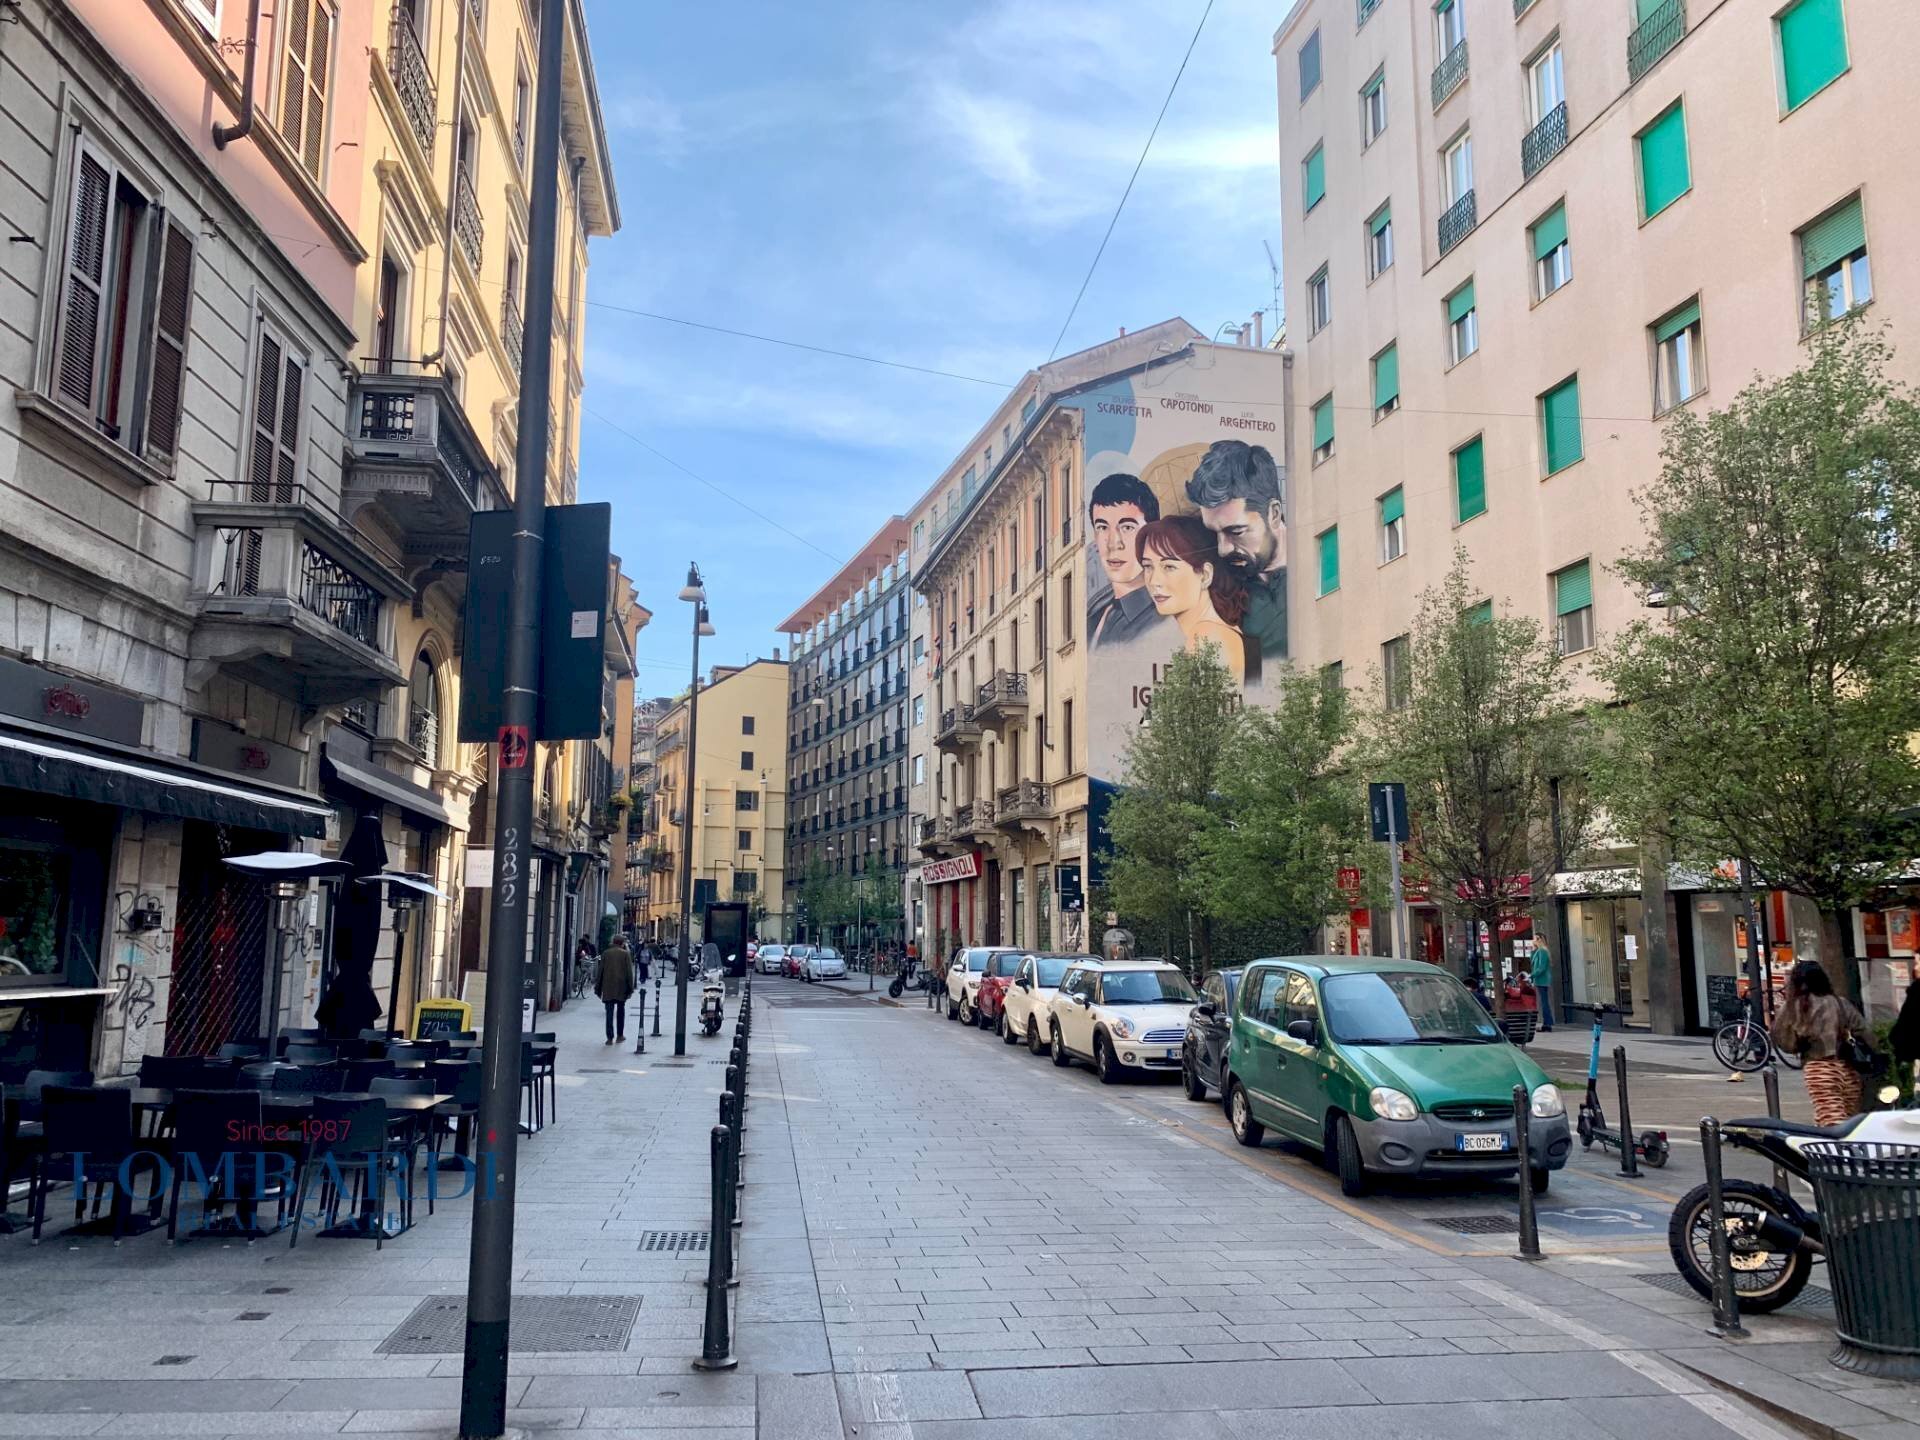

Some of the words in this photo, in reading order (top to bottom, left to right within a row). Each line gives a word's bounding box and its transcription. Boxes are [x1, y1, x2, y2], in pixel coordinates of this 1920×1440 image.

[1097, 402, 1152, 418] SCARPETTA
[1160, 398, 1214, 414] CAPOTONDI
[1219, 416, 1276, 432] ARGENTERO
[501, 826, 520, 907] 282
[923, 856, 974, 883] ROSSIGNOLI
